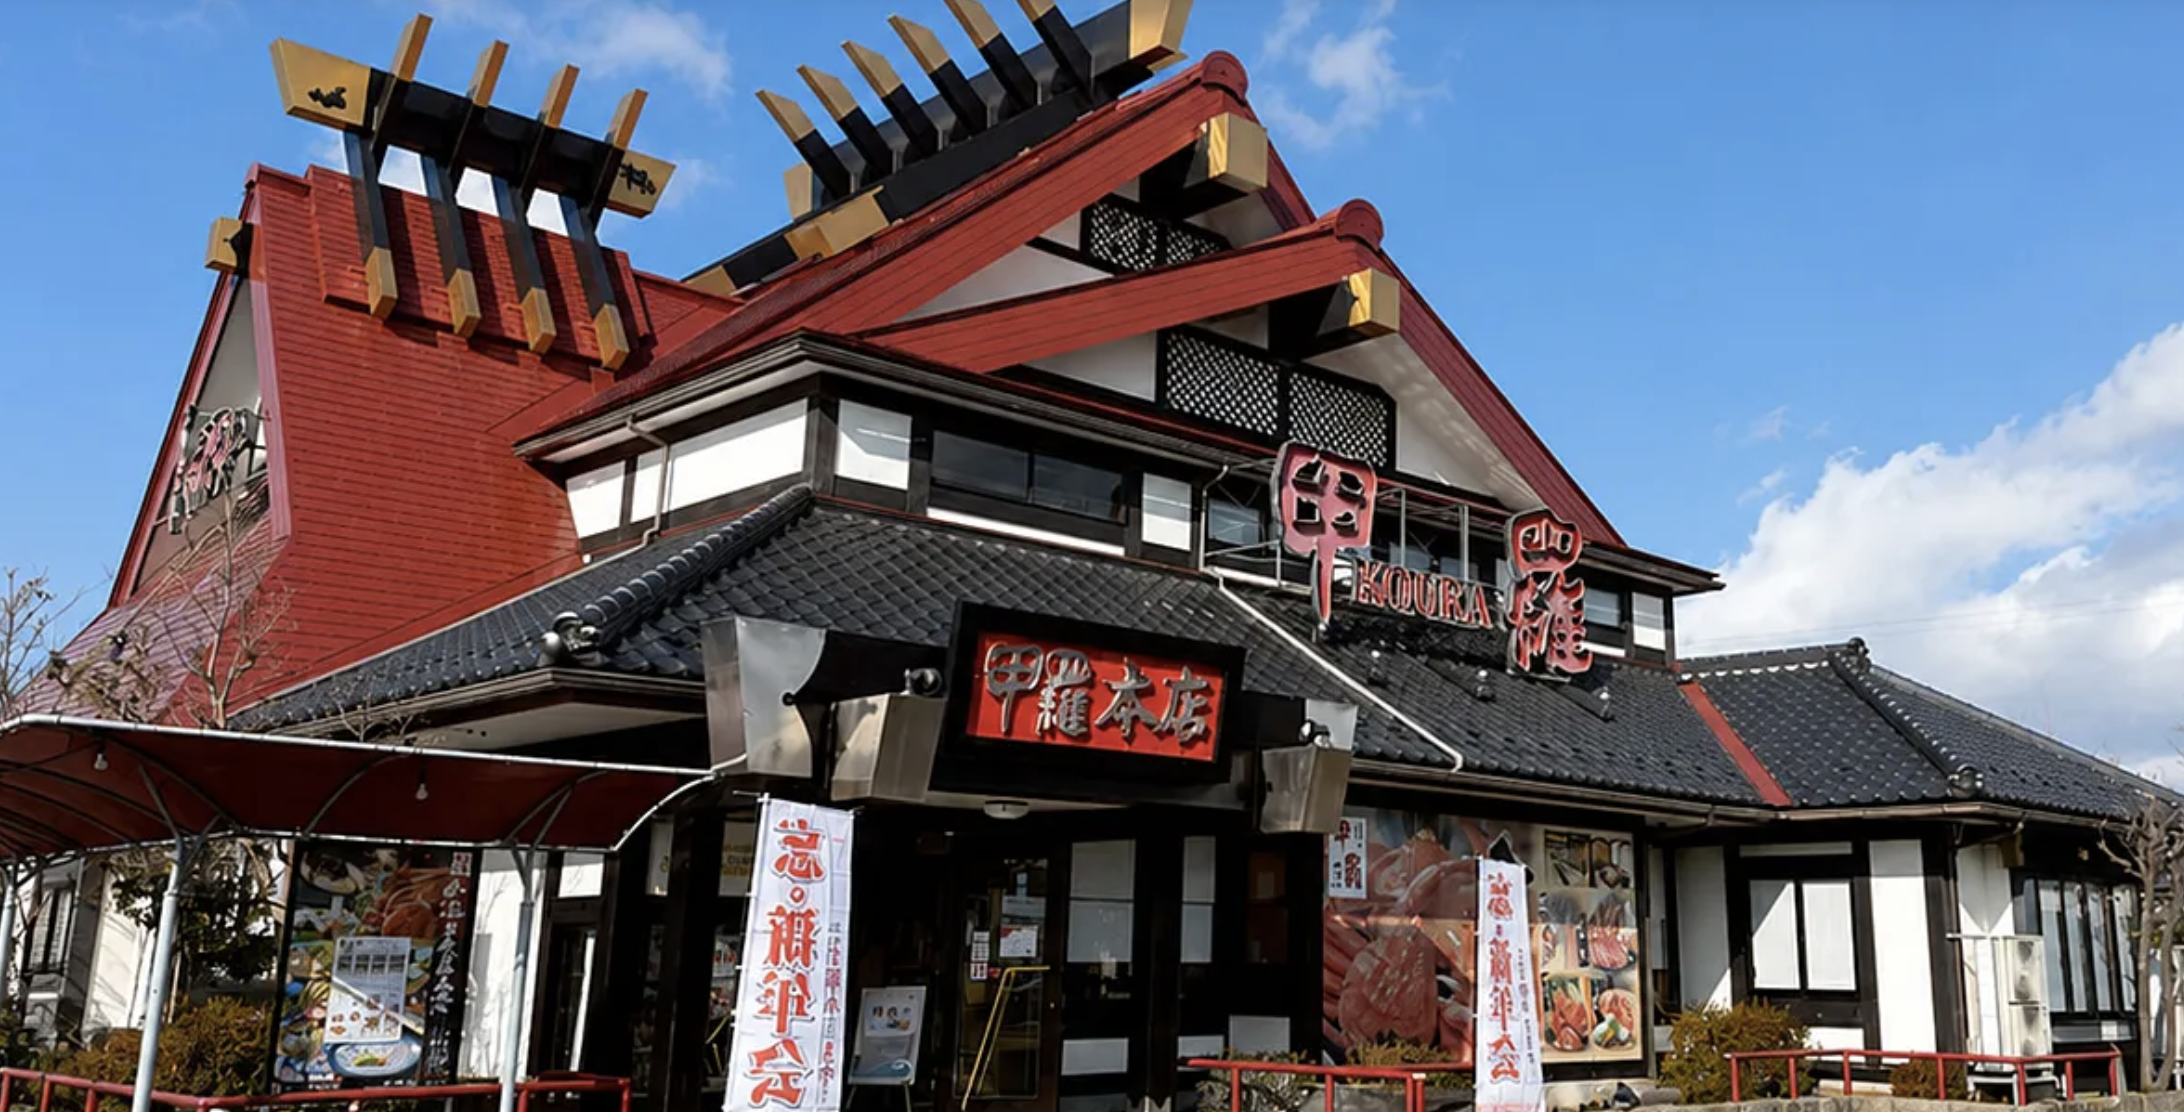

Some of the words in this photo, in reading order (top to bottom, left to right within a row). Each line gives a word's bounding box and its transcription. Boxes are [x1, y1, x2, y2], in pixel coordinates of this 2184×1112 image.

[1356, 558, 1492, 628] KOURA
[984, 641, 1208, 742] 甲羅本店
